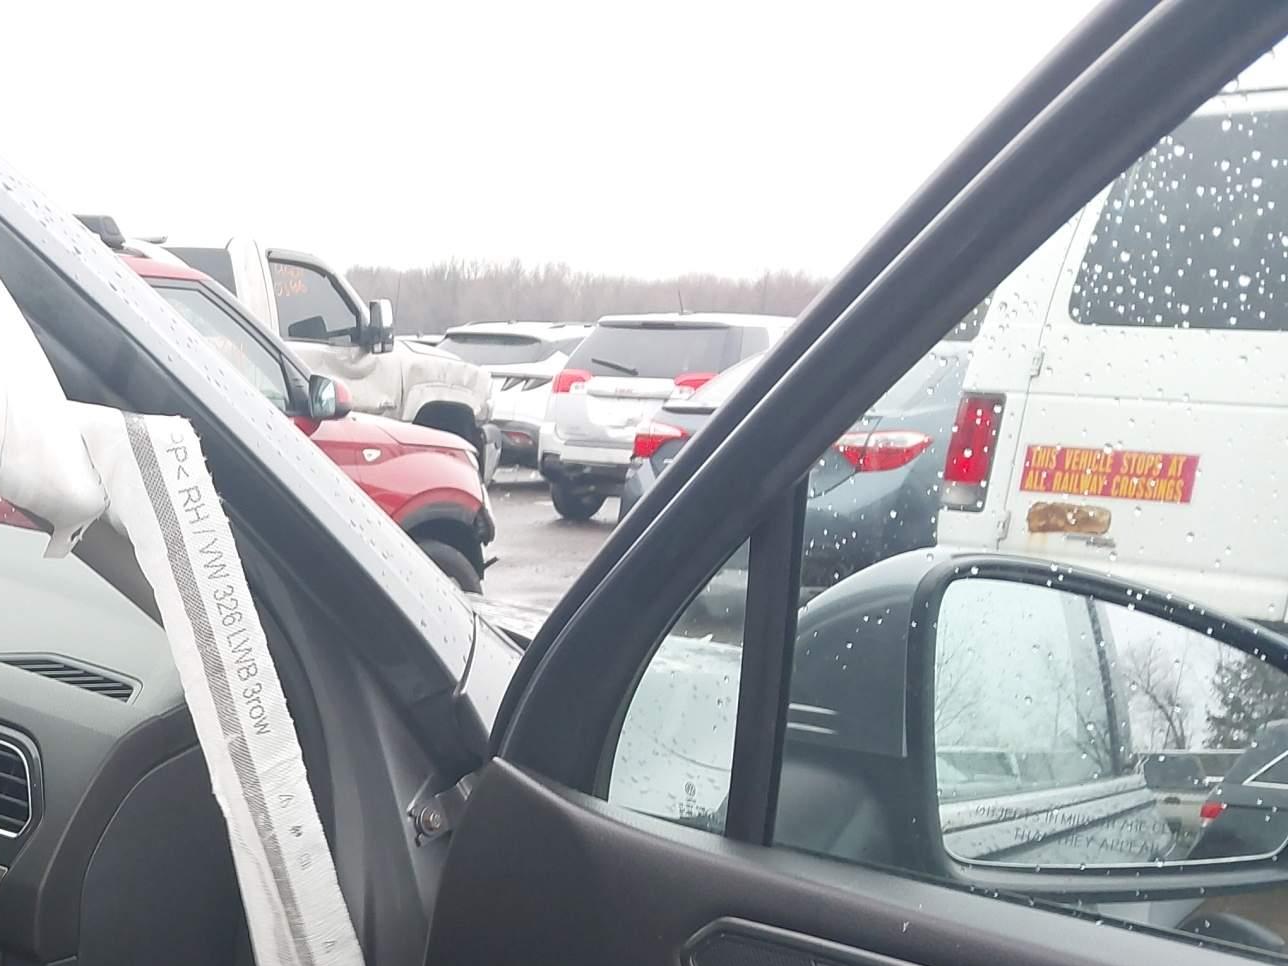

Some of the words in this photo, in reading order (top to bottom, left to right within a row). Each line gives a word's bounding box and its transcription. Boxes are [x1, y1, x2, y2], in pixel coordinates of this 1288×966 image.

[1030, 448, 1059, 470] THIS
[1064, 450, 1113, 473] VEHICLE
[1120, 453, 1162, 476] STOPS
[1168, 456, 1187, 477] AT
[178, 485, 210, 524] RH
[1024, 470, 1047, 491] ALL
[1052, 471, 1107, 495] RAILWAY
[1113, 475, 1185, 503] CROSSINGS
[199, 537, 231, 580] VW
[213, 585, 243, 627] 326
[226, 628, 259, 681] LWB
[242, 682, 271, 735] 3row
